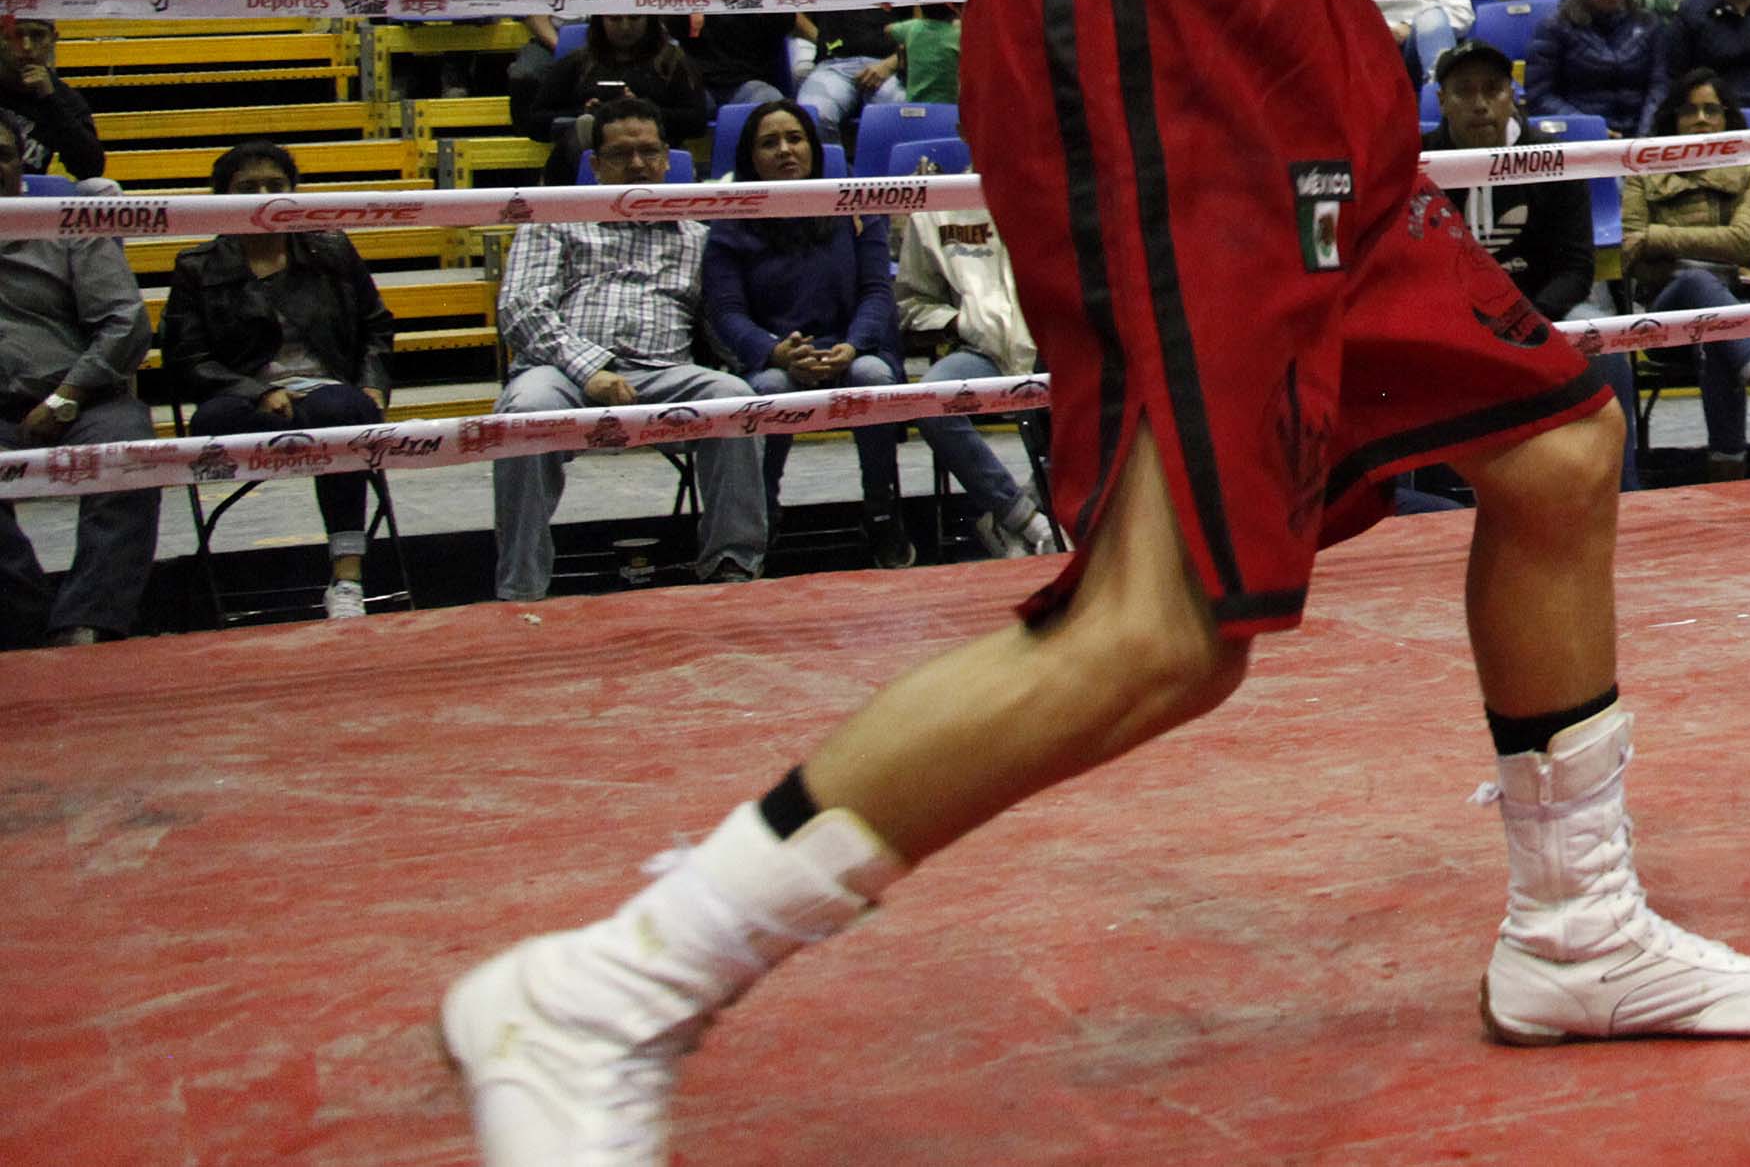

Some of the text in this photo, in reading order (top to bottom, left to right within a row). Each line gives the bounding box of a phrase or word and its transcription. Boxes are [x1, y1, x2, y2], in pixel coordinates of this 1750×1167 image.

[1637, 140, 1744, 163] GENTE
[1489, 149, 1565, 176] ZAMORA
[836, 186, 928, 207] ZAMORA
[60, 207, 169, 228] ZAMORA
[392, 436, 443, 451] JYM
